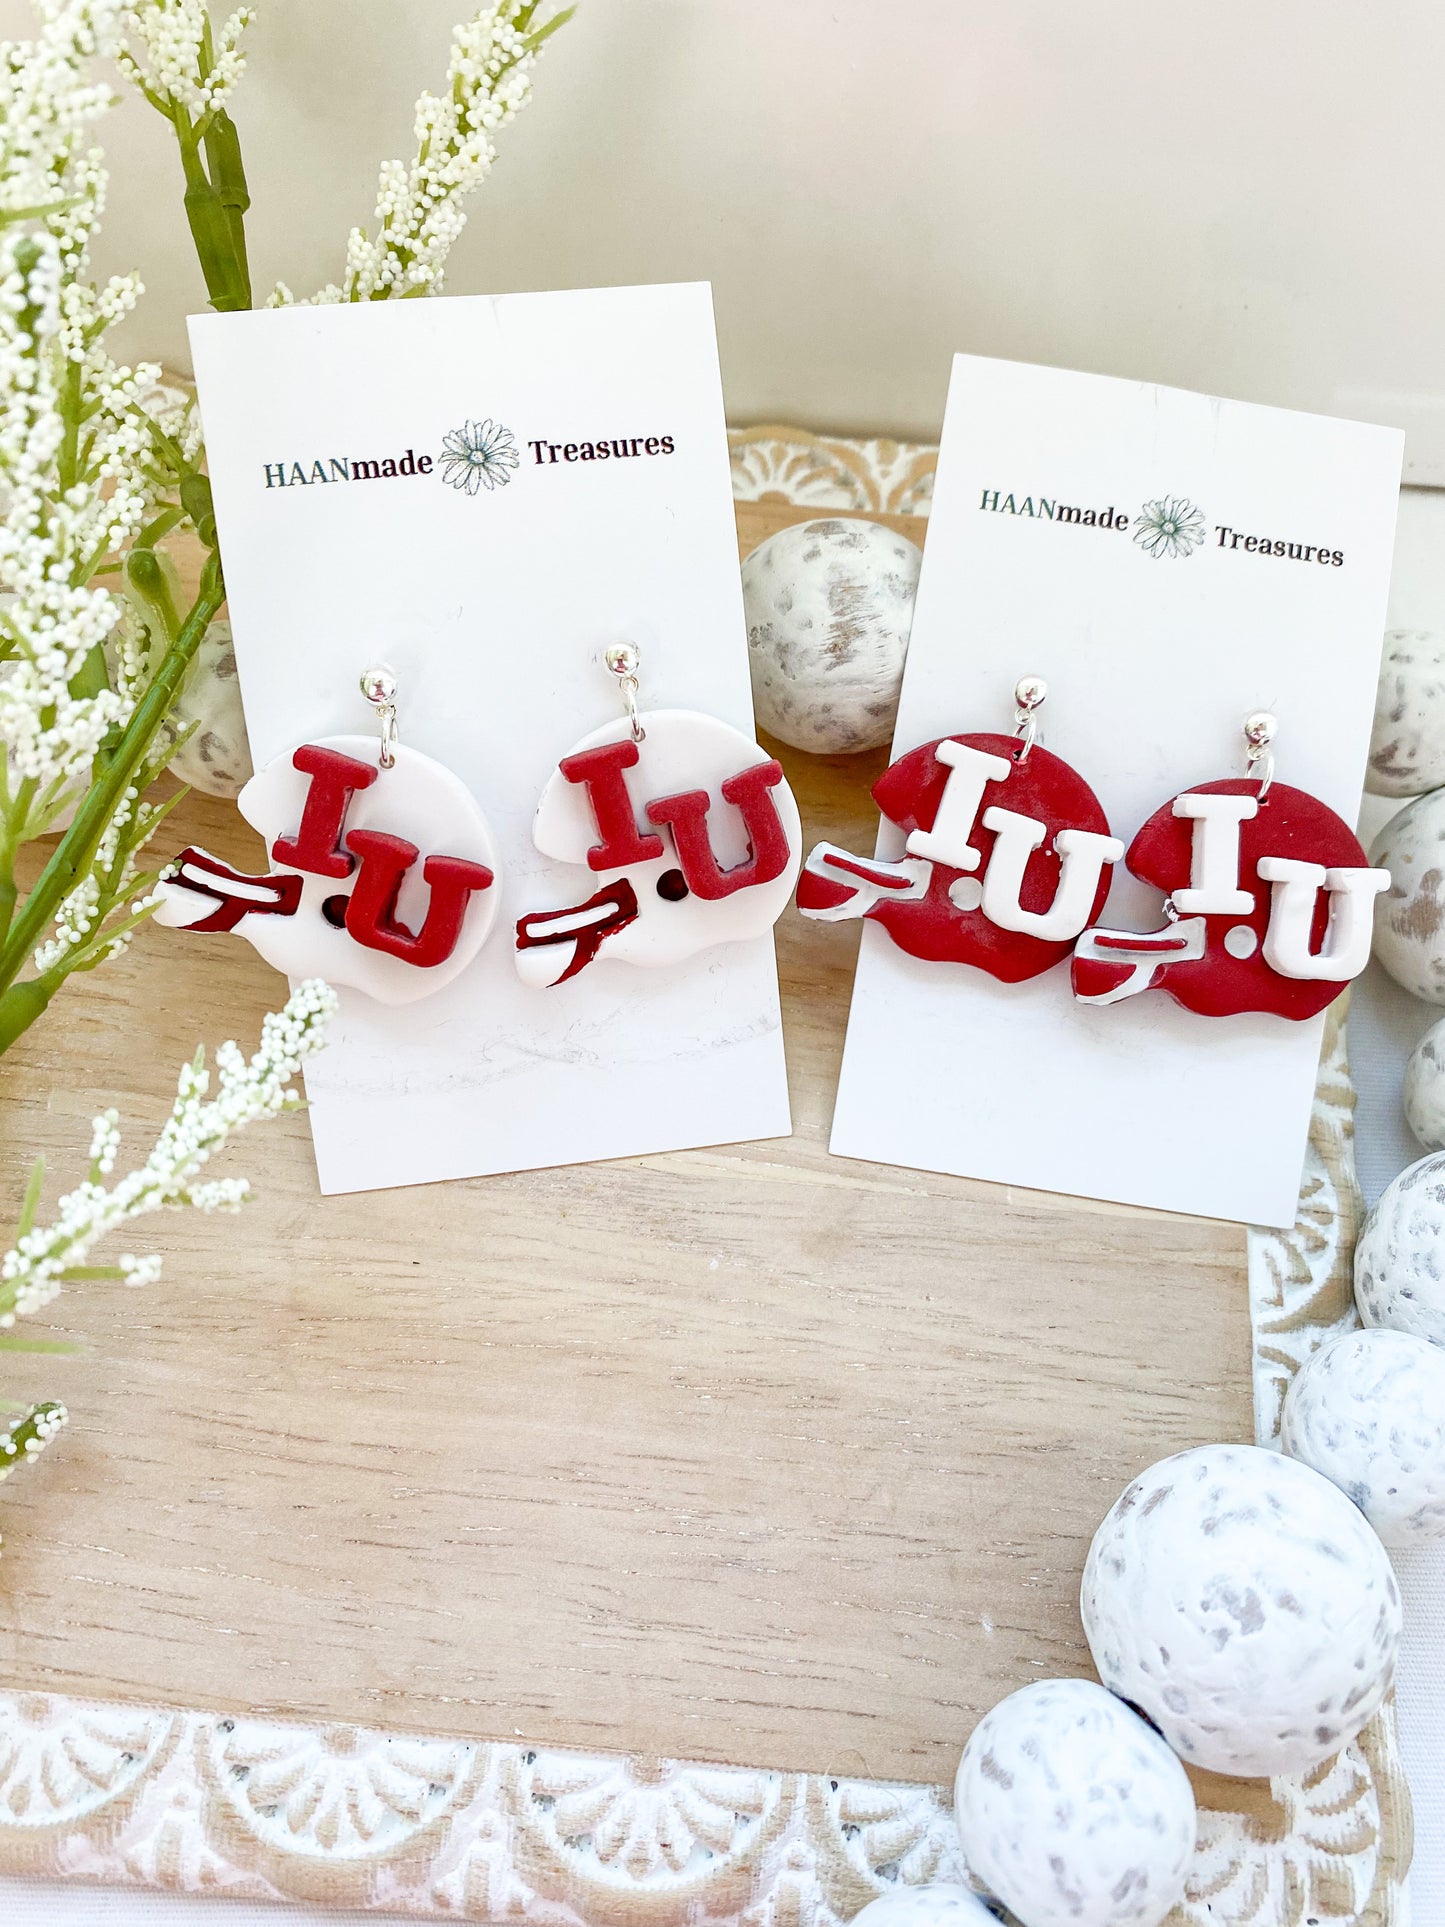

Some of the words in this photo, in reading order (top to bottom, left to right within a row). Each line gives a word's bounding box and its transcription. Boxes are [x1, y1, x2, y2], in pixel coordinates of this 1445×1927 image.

[263, 449, 434, 488] HAANmade
[528, 435, 676, 464] Treasures
[979, 490, 1130, 532] HAANmade
[1215, 525, 1345, 567] Treasures
